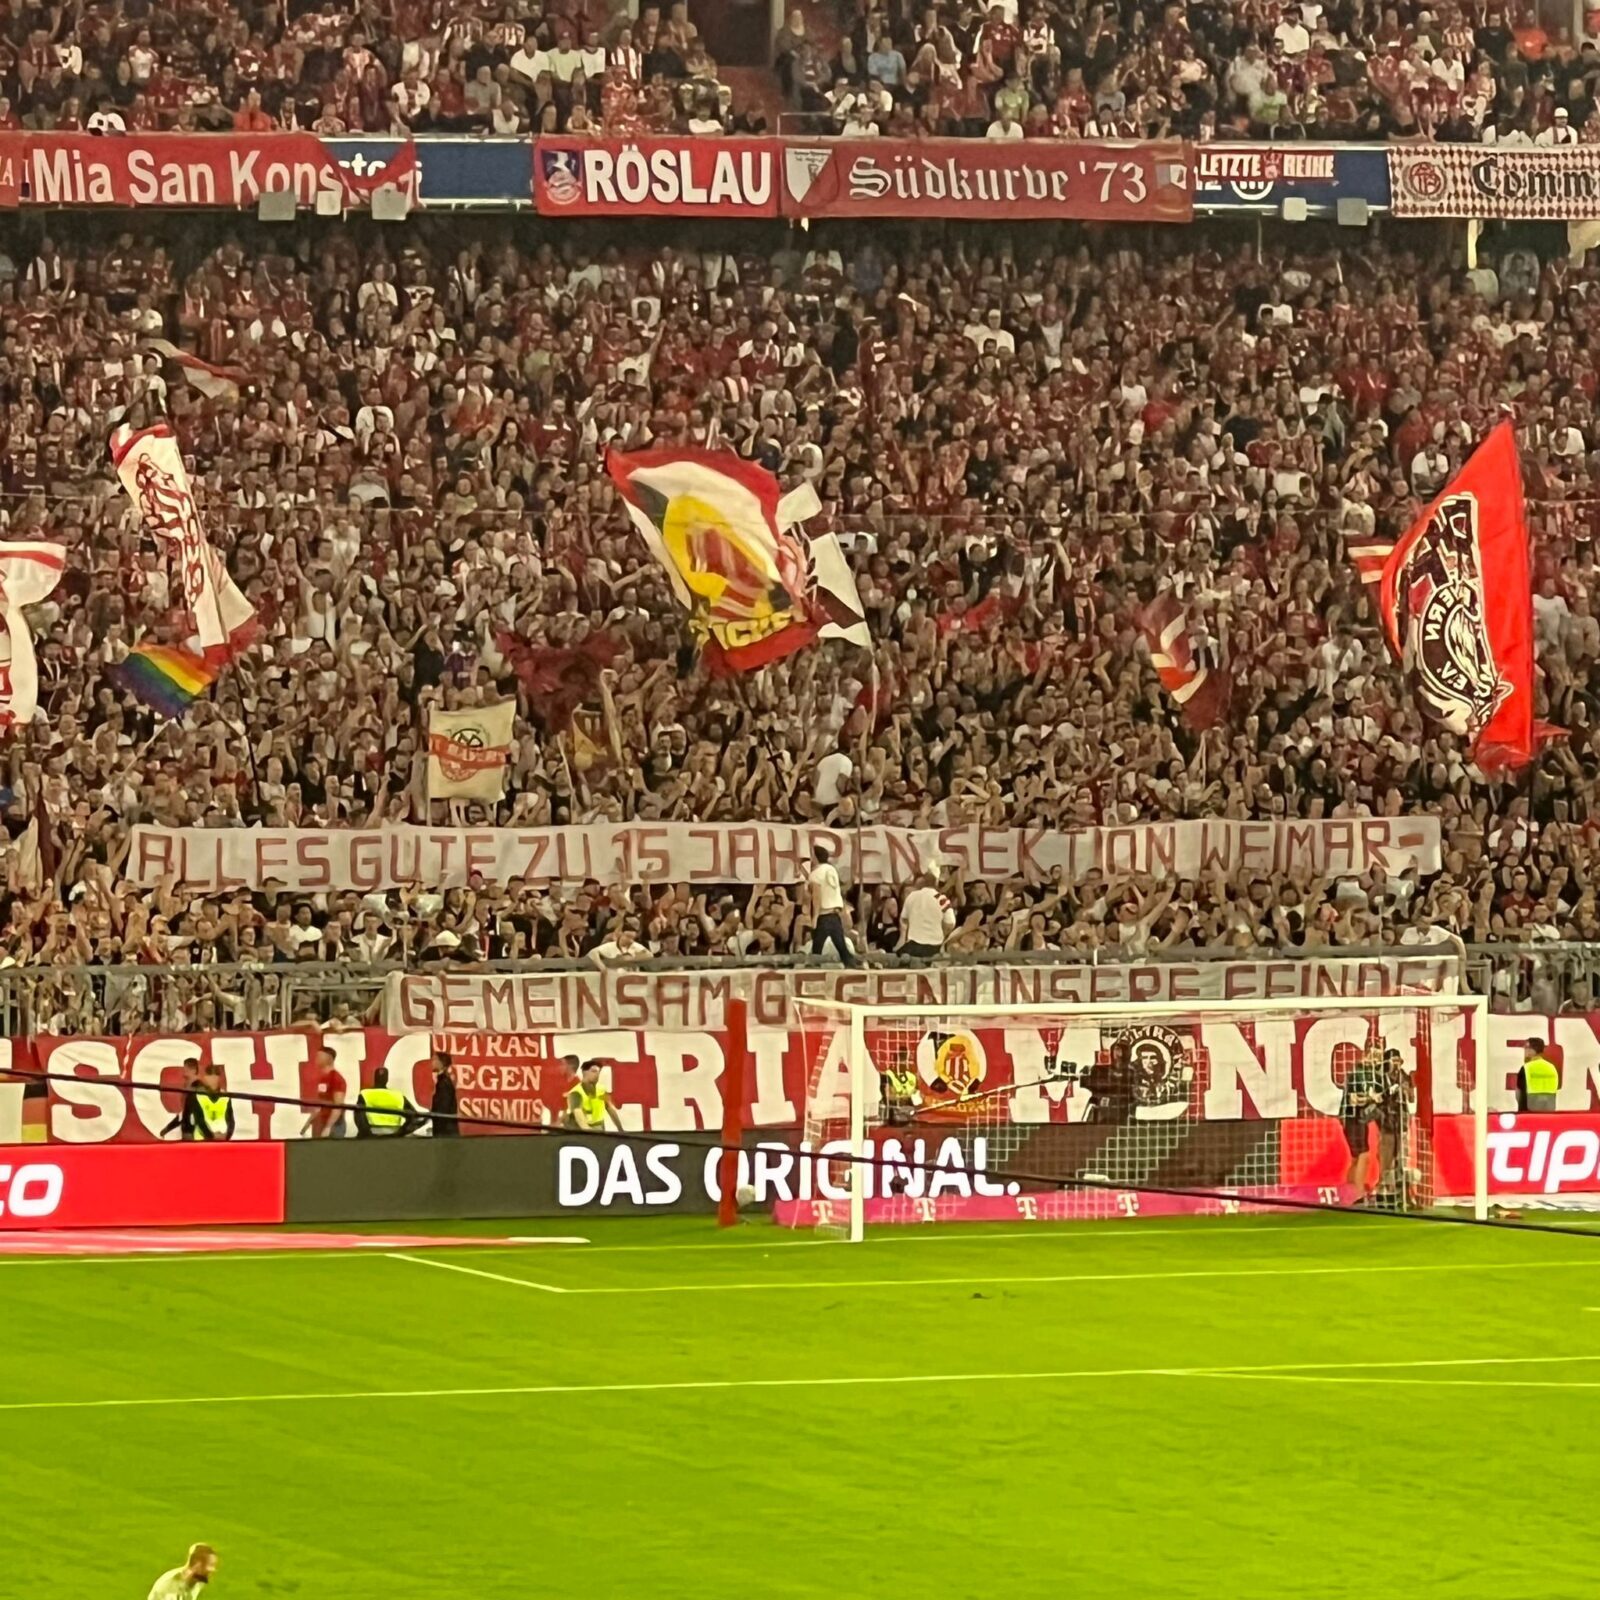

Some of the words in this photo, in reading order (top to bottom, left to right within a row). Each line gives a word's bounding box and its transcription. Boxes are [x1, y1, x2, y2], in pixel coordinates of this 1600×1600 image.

[33, 149, 114, 202] Mia
[127, 150, 215, 204] San
[584, 144, 772, 205] RÖSLAU
[848, 155, 1069, 201] Südkurve
[1078, 160, 1148, 204] '73
[1201, 153, 1262, 177] LETZTE
[1472, 155, 1594, 199] Comm
[139, 832, 288, 888] ALLES
[351, 835, 499, 887] GUTE
[518, 832, 593, 880] ZU
[611, 828, 668, 880] 15
[938, 826, 1177, 878] SEKTION
[401, 972, 734, 1029] GEMEINSAM
[432, 1031, 540, 1057] ULTRAS
[447, 1064, 542, 1091] EGEN
[459, 1097, 545, 1124] SSISMUS
[559, 1143, 682, 1207] DAS
[704, 1136, 1021, 1205] ORIGINAL.
[1487, 1113, 1600, 1193] tip
